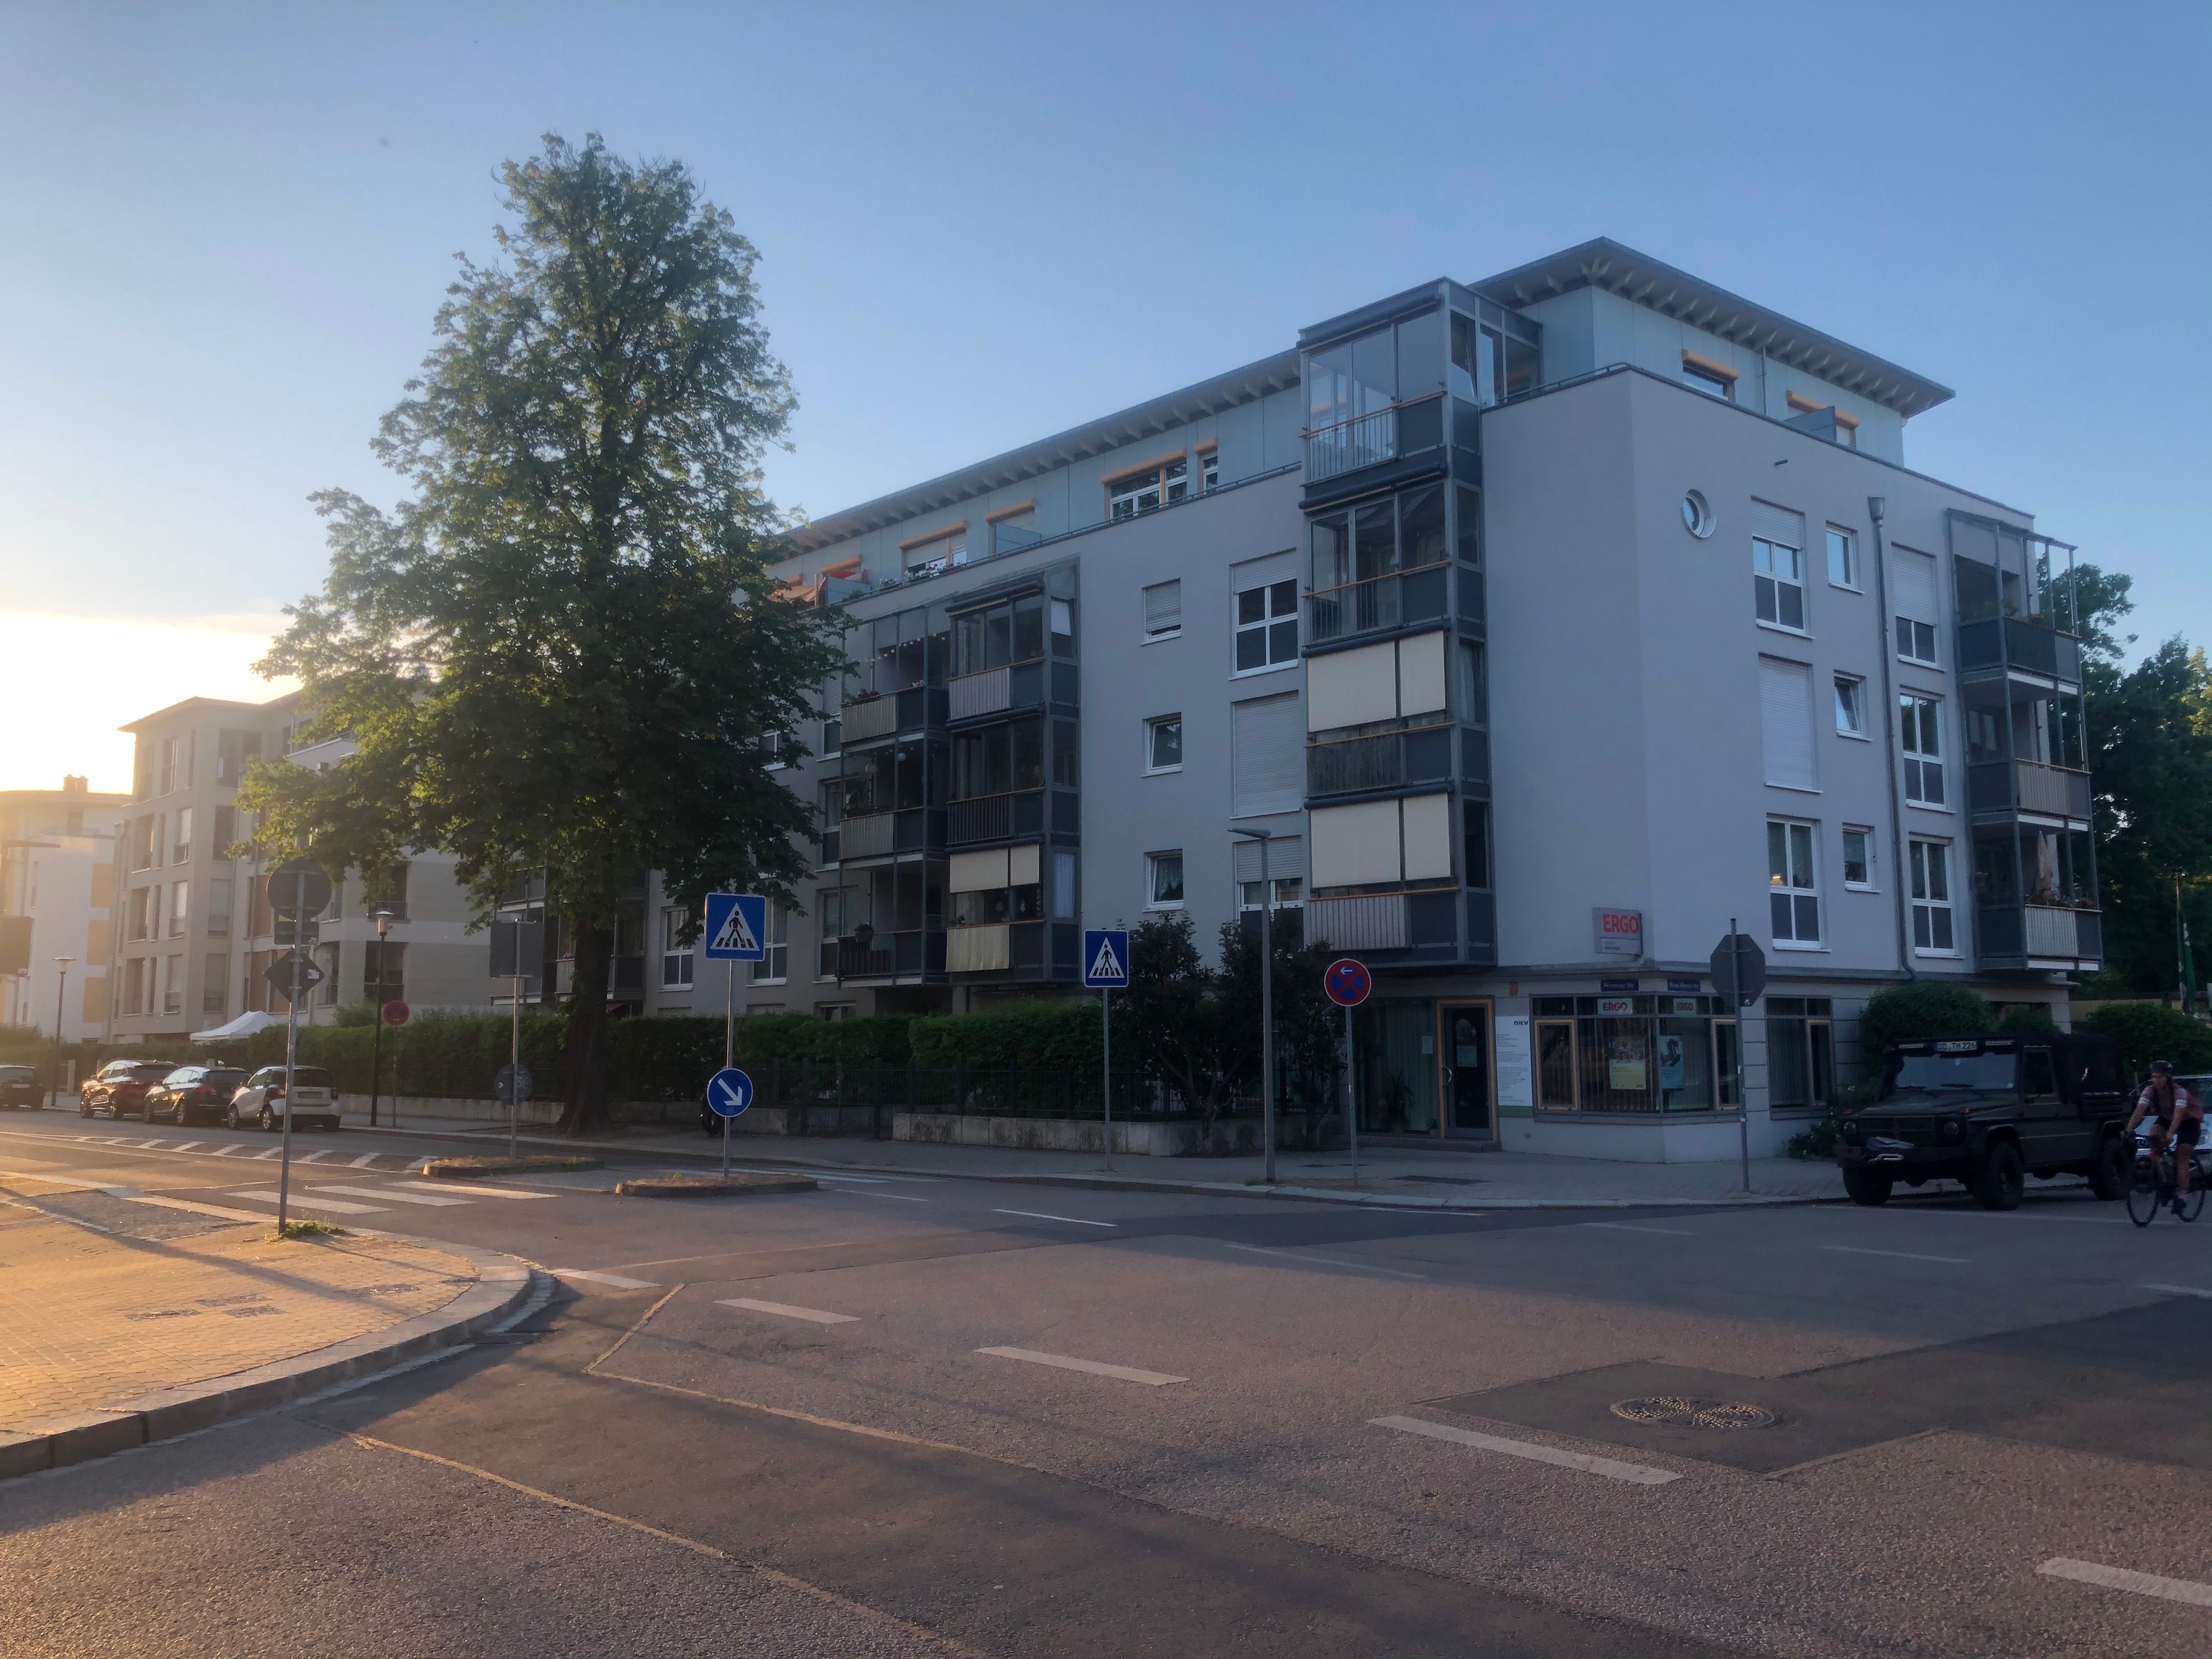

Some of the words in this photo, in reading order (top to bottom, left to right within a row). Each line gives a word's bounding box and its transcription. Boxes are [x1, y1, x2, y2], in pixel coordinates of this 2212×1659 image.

[1602, 913, 1639, 934] ERGO
[1602, 1002, 1628, 1011] ERGO
[1677, 1002, 1694, 1011] ERGO
